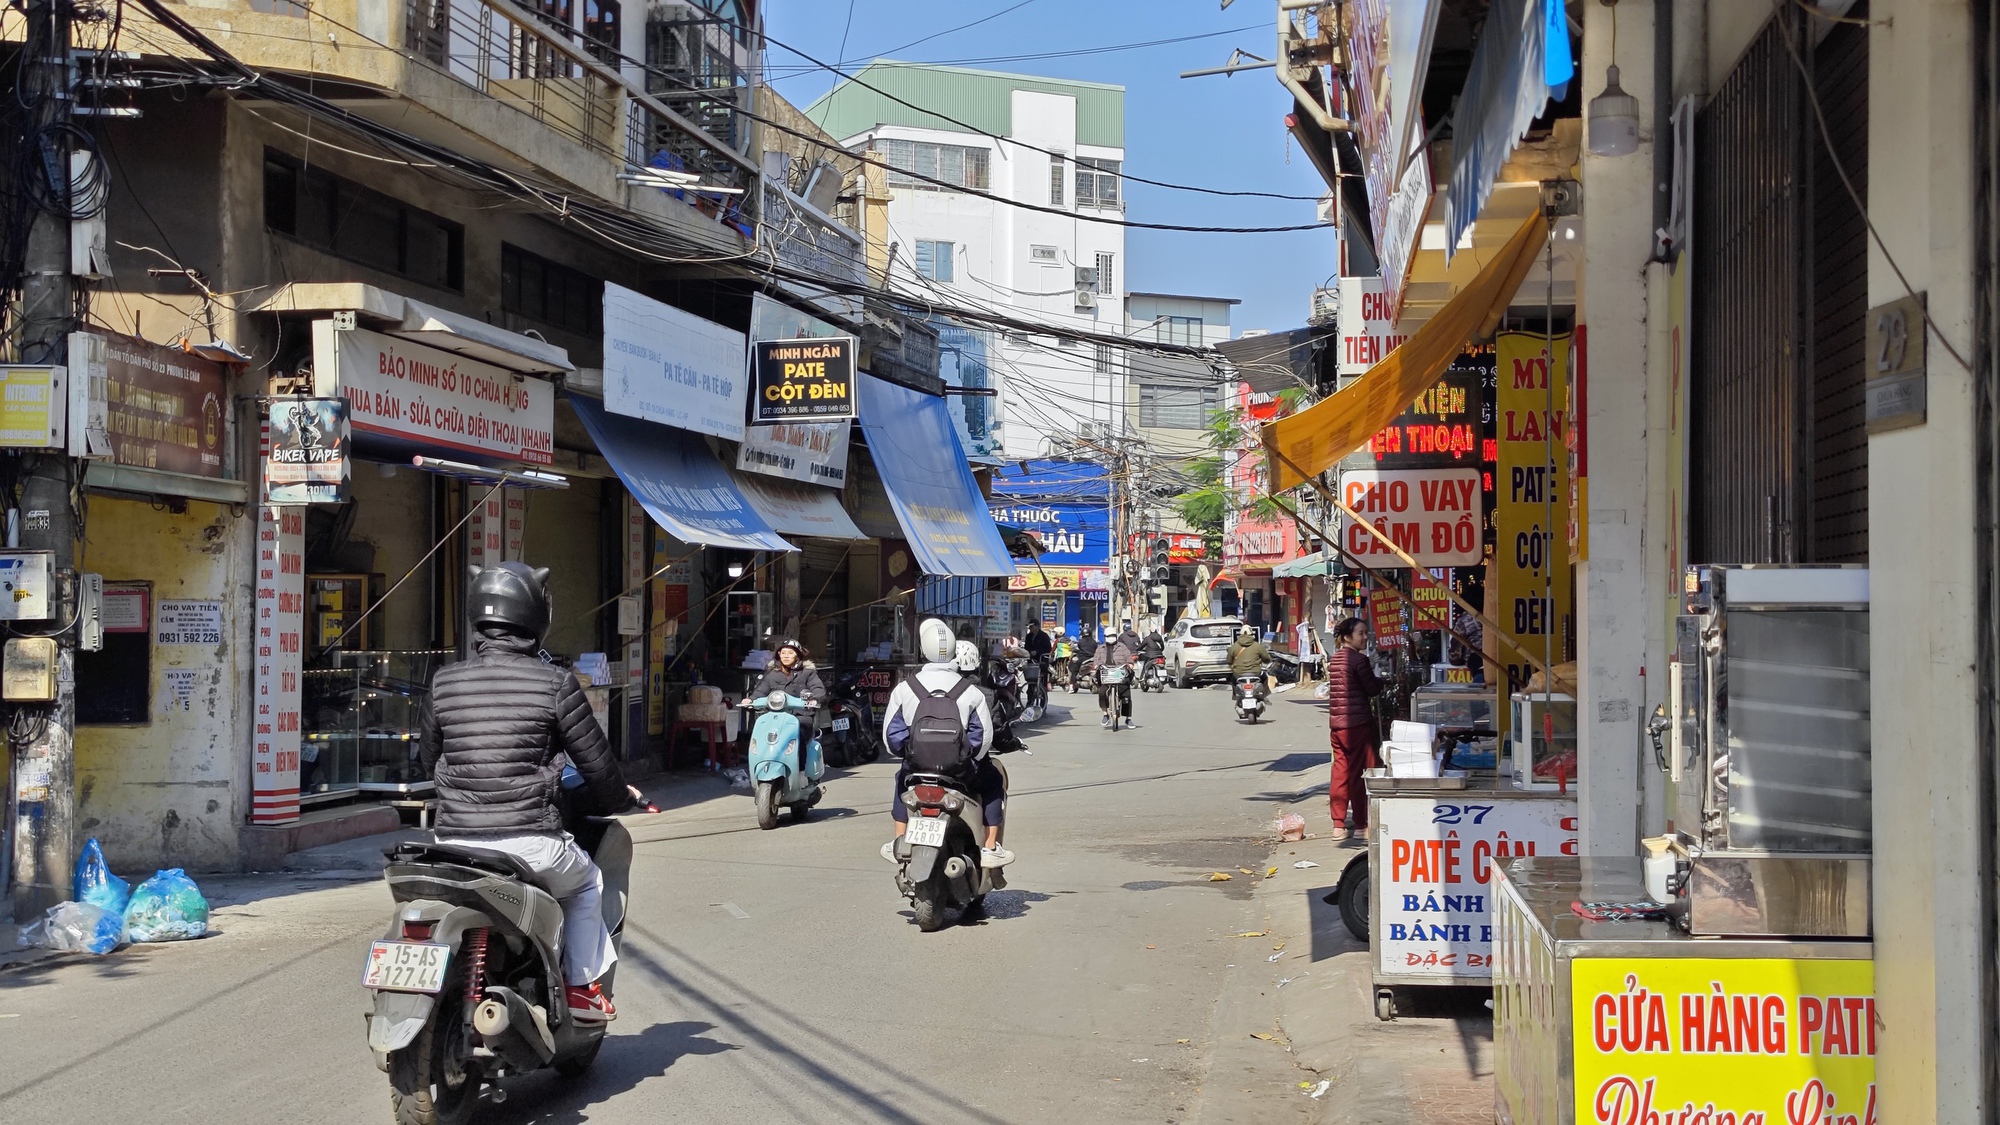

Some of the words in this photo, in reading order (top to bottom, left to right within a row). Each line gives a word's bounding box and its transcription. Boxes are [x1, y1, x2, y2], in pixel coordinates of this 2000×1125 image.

[1345, 327, 1380, 364] TIỀN
[1875, 309, 1907, 372] 29
[769, 348, 801, 360] MINH
[803, 344, 840, 358] NGÂN
[379, 346, 405, 379] BẢO
[409, 361, 439, 389] MINH
[441, 363, 458, 392] SỐ
[460, 373, 471, 398] 10
[474, 375, 501, 403] CHÙA
[502, 385, 529, 411] HNG
[664, 361, 673, 381] PA
[703, 373, 711, 392] PA
[784, 362, 826, 379] PATE
[5, 384, 47, 402] INTERNET
[765, 380, 804, 404] CỘT
[809, 378, 846, 399] ĐÈN
[344, 385, 371, 413] MUA
[375, 388, 400, 420] BÁN
[410, 396, 431, 428] SỬA
[435, 405, 464, 435] CHỮA
[468, 411, 489, 445] ĐIỆN
[492, 420, 519, 451] THOẠI
[521, 431, 551, 452] NHANH
[1505, 410, 1564, 442] LAN
[1406, 424, 1474, 458] THOẠI
[273, 449, 306, 463] BIKER
[309, 449, 340, 463] VAPE
[1346, 480, 1409, 513] CHO
[1421, 479, 1476, 512] VAY
[1011, 506, 1060, 523] THUỐC
[1039, 528, 1085, 553] HÂU
[1348, 515, 1420, 556] CẦM
[1432, 512, 1476, 553] ĐỒ
[1515, 523, 1555, 578] CỘT
[1011, 576, 1027, 587] 26
[1053, 577, 1069, 588] 26
[200, 602, 218, 611] TIỀN
[1080, 591, 1108, 600] KANG
[159, 632, 180, 643] 0931
[183, 632, 200, 643] 592
[202, 632, 219, 643] 226
[857, 672, 890, 687] ATE
[1432, 805, 1494, 825] 27
[914, 820, 941, 833] 15-B3
[908, 831, 942, 845] 748.07
[1392, 830, 1461, 884] PATÊ
[1402, 890, 1484, 913] BÁNH
[1390, 919, 1471, 942] BÁNH
[394, 945, 440, 967] 15-AS
[1406, 949, 1458, 970] ĐẶC
[384, 966, 438, 988] 127.44
[1594, 974, 1670, 1053] CỬA
[1681, 982, 1786, 1054] HÀNG
